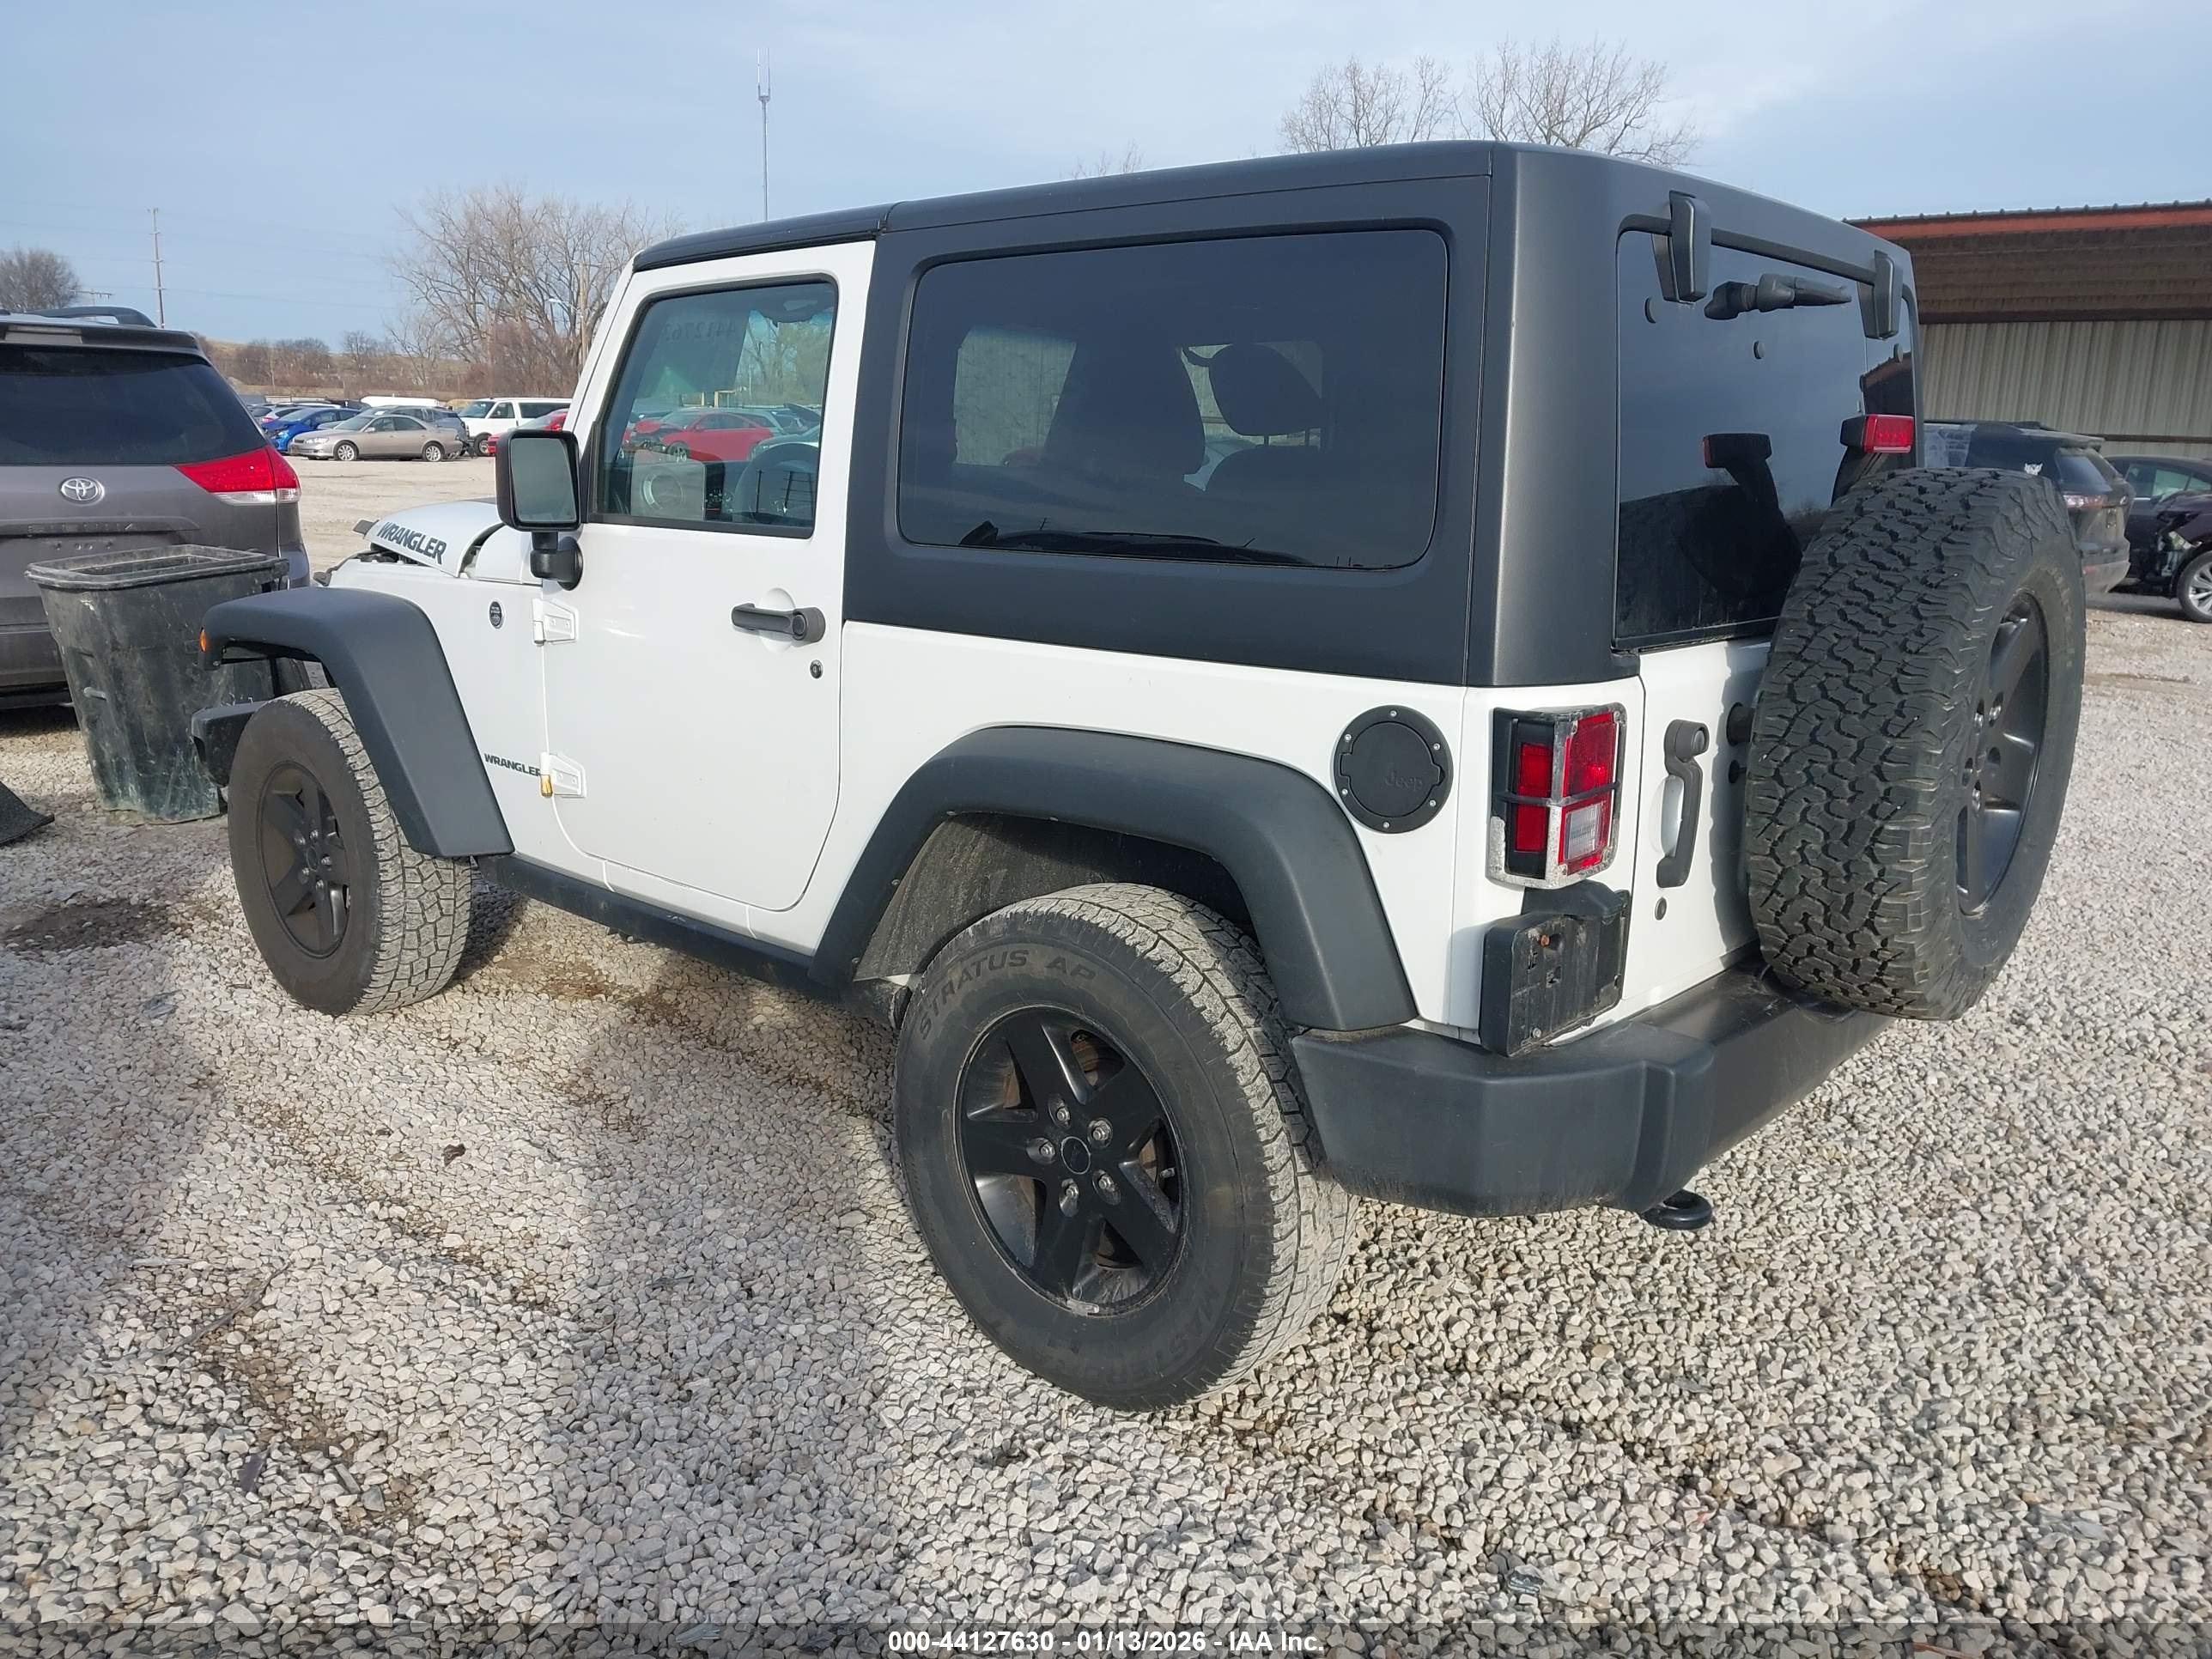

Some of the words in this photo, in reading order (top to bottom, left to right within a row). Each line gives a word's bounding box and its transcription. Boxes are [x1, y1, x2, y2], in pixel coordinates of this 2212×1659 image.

[377, 522, 447, 565] WRANGLER
[483, 753, 541, 776] WRANGLER
[920, 950, 1029, 1040] STRATUS
[1045, 957, 1097, 979] AP
